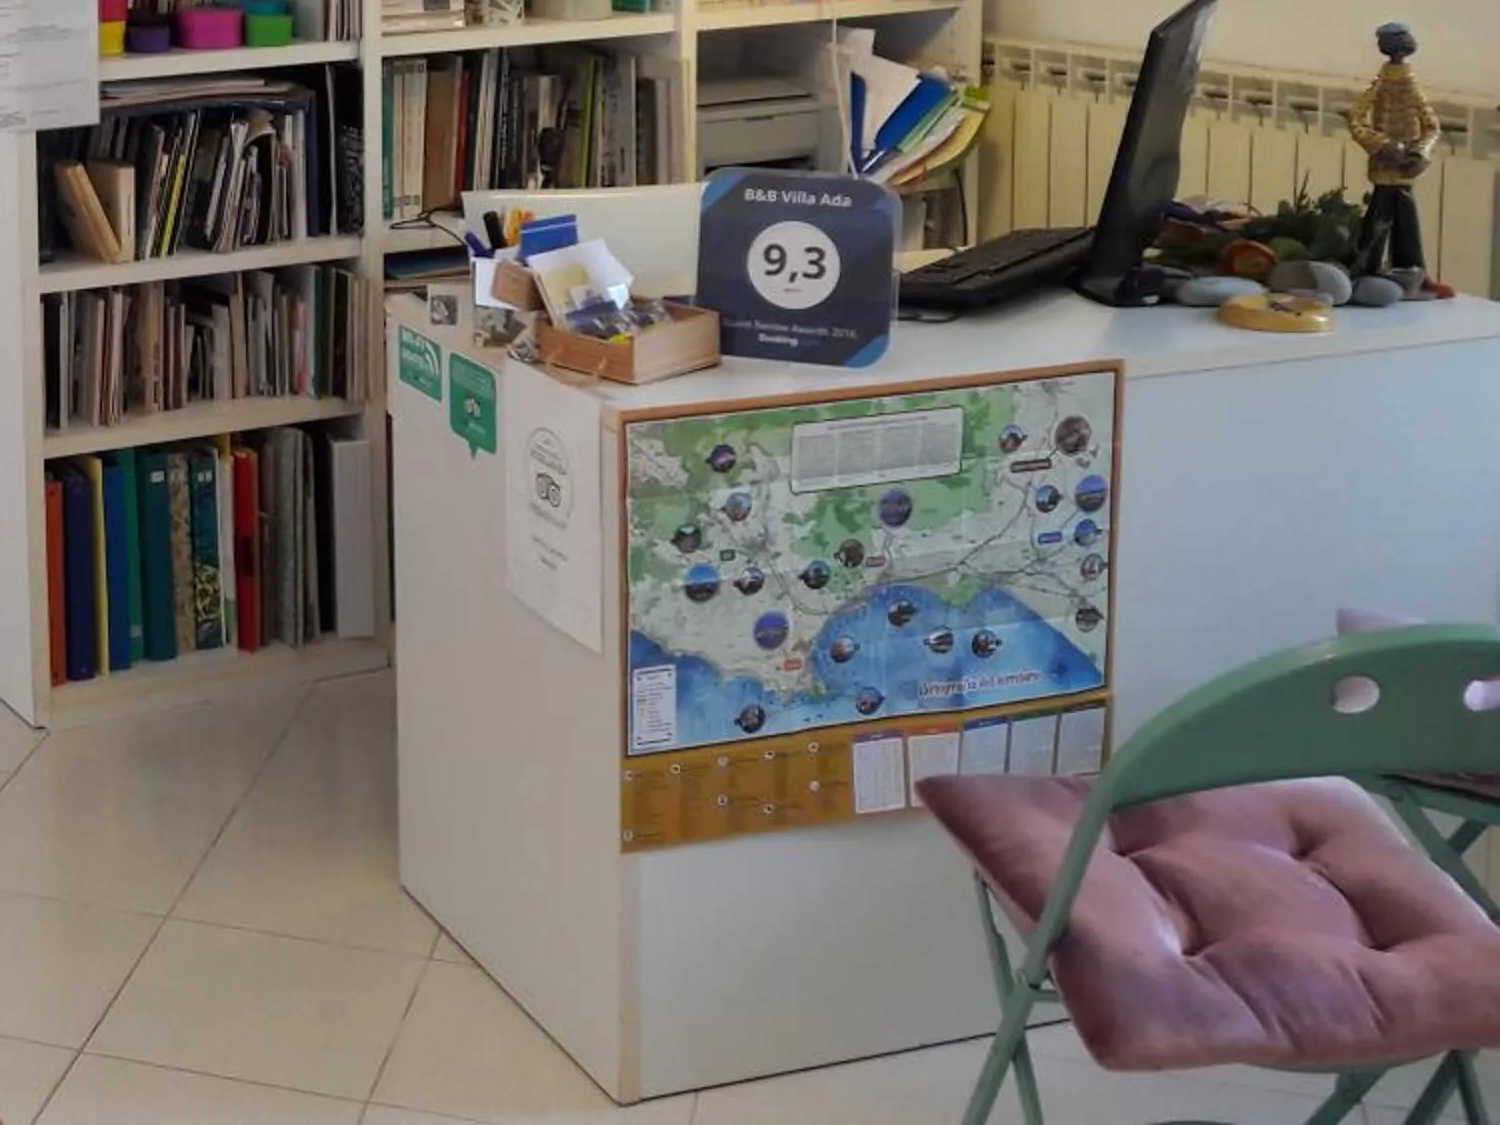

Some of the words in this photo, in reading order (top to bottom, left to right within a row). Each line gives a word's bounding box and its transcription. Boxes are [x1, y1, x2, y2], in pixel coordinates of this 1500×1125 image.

[743, 188, 777, 203] B&B
[781, 190, 816, 205] Villa
[820, 192, 853, 208] Ada
[762, 243, 827, 284] 9,3
